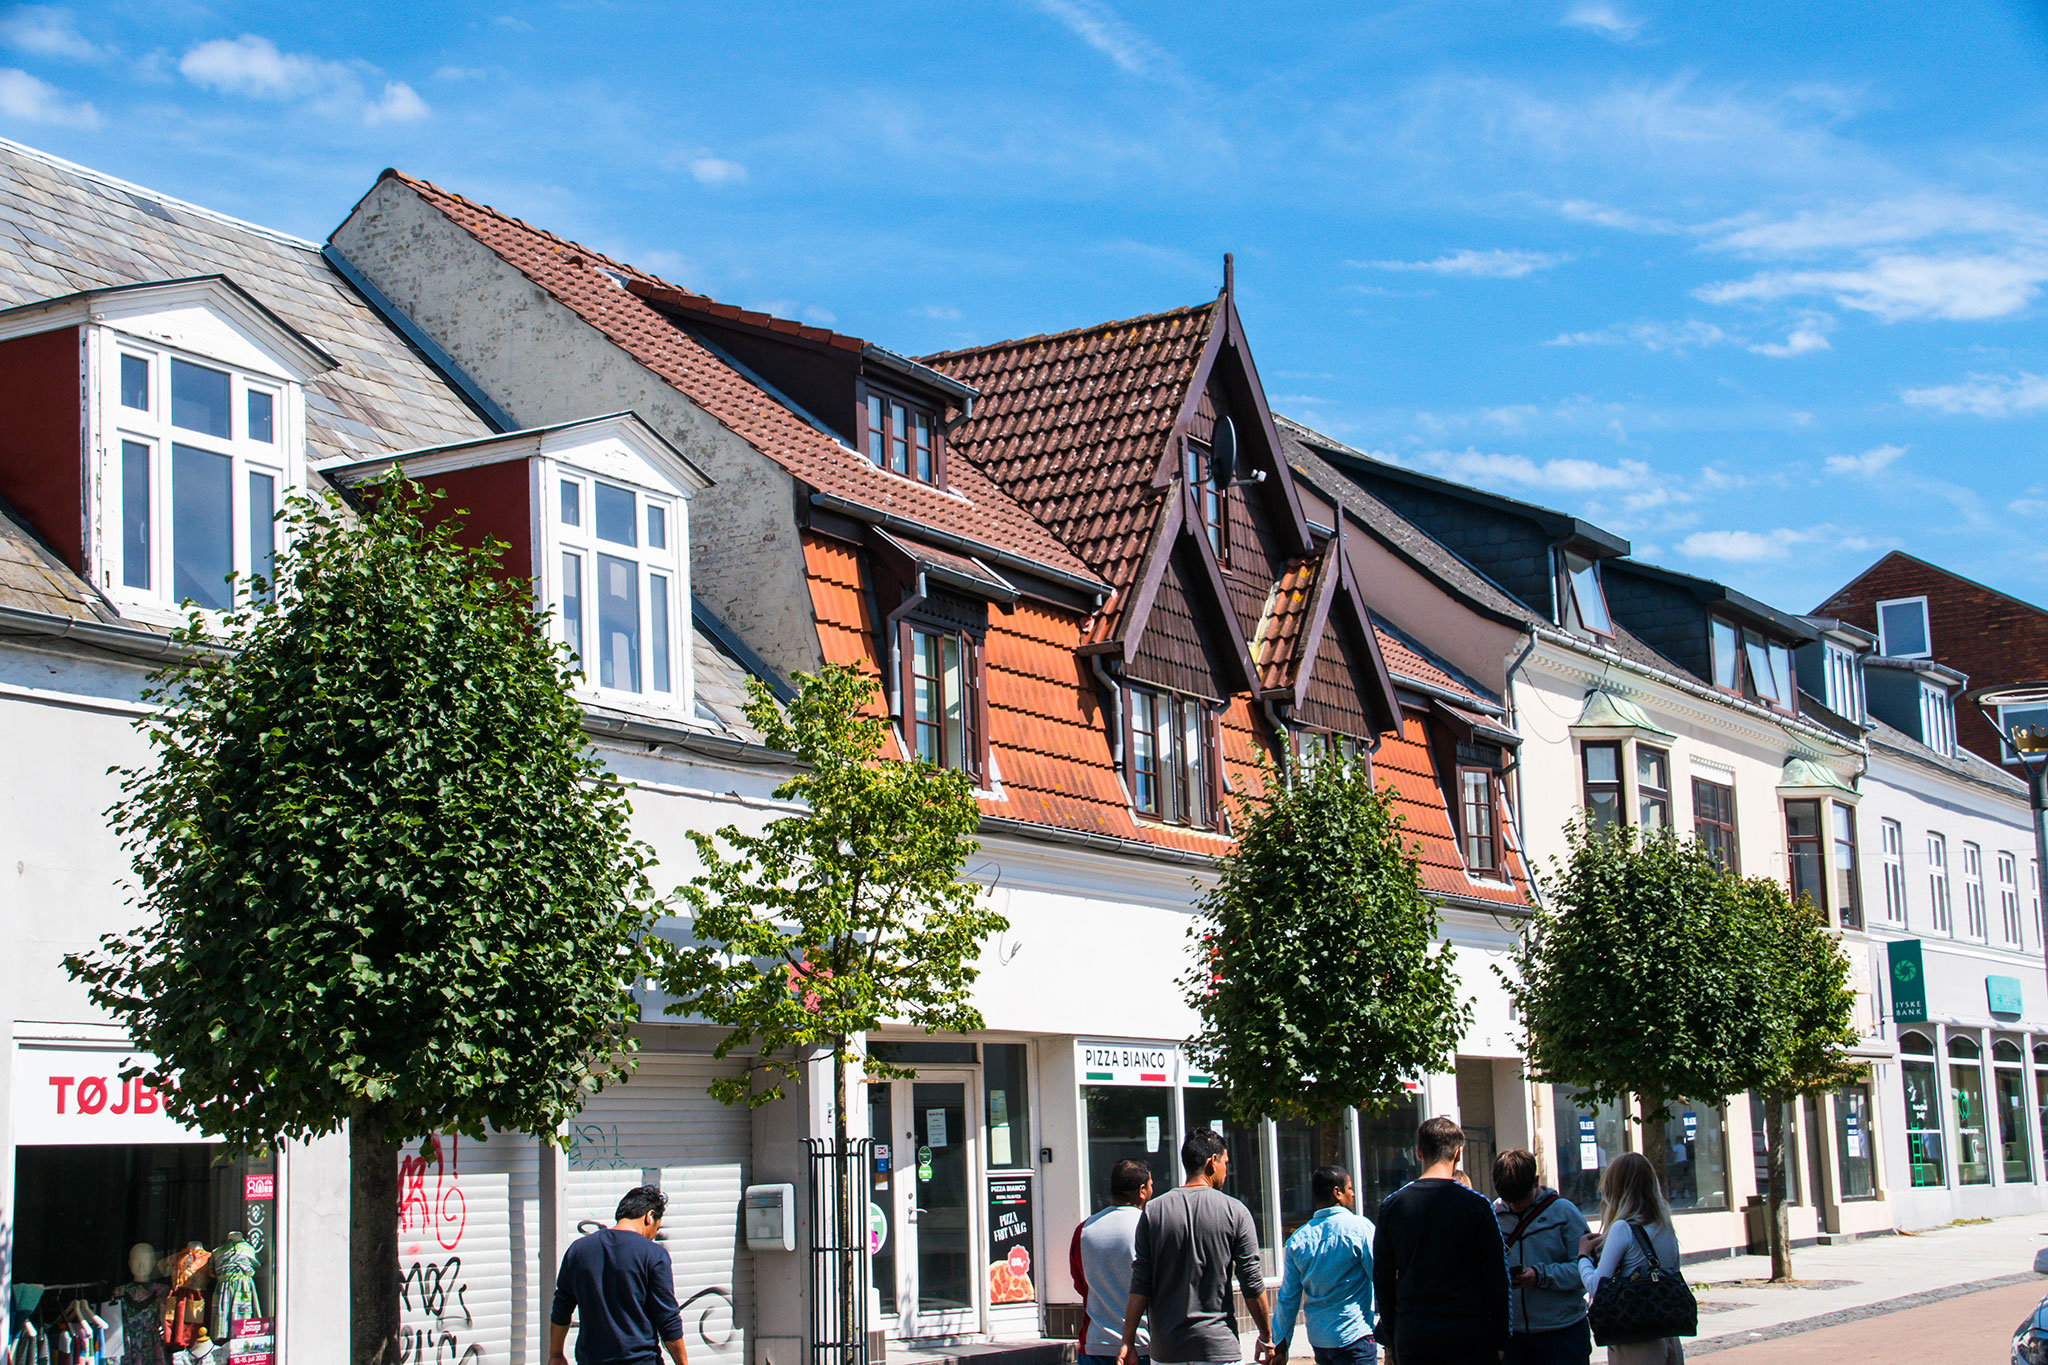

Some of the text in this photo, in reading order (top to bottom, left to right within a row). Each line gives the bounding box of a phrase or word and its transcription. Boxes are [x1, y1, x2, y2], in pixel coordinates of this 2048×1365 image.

[1895, 1009, 1922, 1017] BANK
[1086, 1049, 1166, 1069] PIZZA BIANCO
[48, 1076, 172, 1115] TØJB
[999, 1211, 1018, 1227] PIZZA
[993, 1222, 1027, 1242] FRIT VALG
